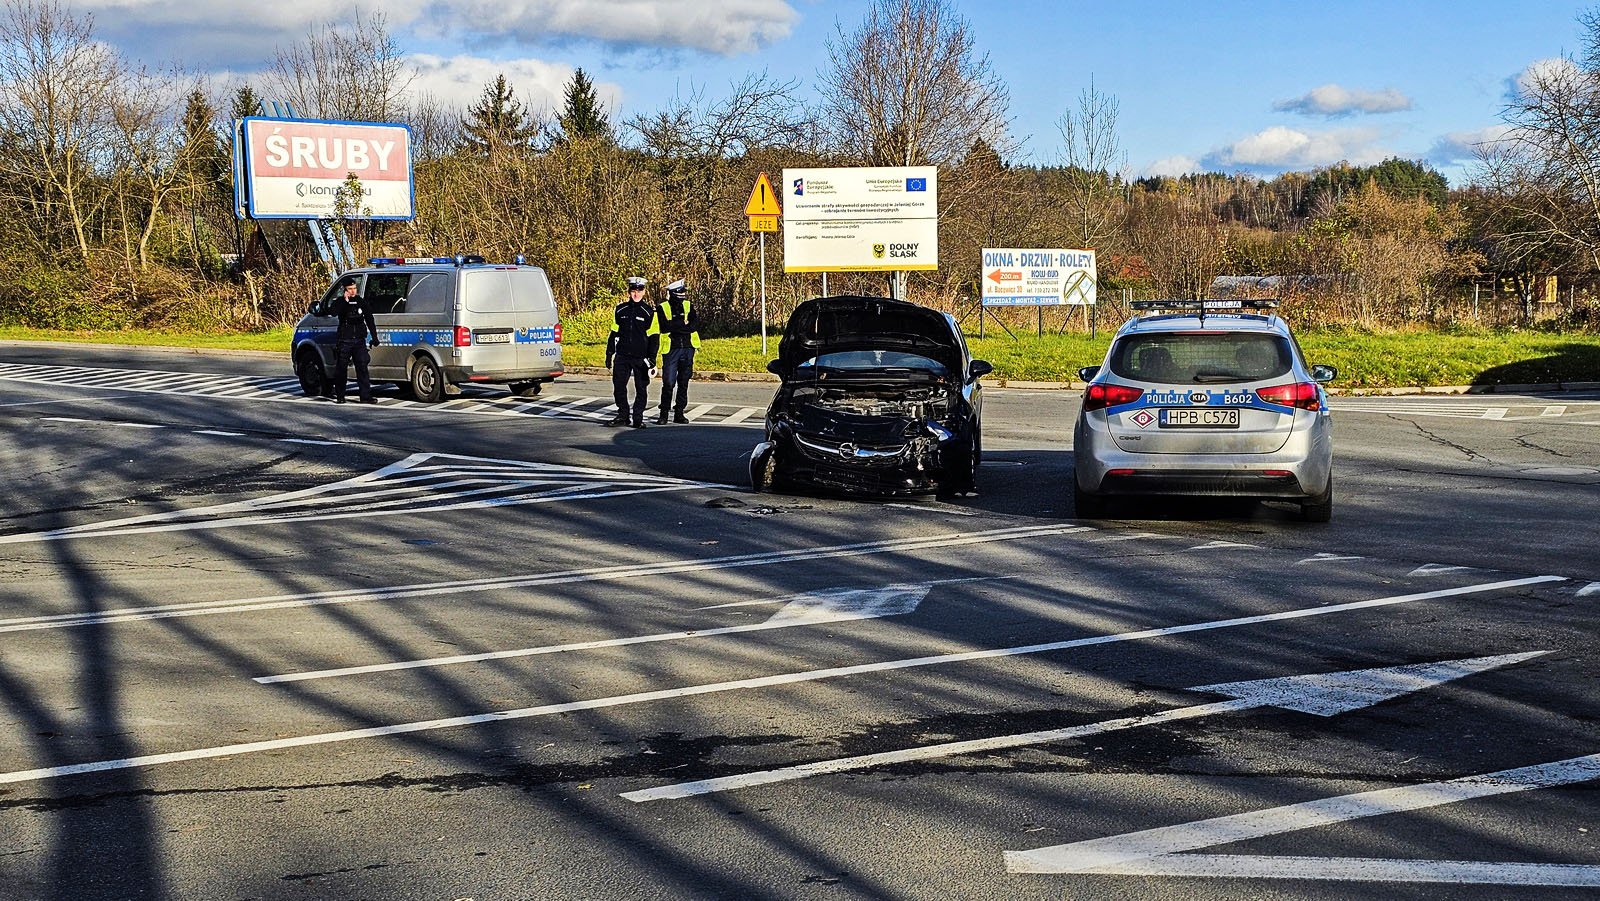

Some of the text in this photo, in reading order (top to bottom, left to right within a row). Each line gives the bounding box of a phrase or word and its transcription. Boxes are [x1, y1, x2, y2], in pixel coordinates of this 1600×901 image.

[265, 128, 395, 170] ŚRUBY
[890, 243, 919, 251] DOLNY
[985, 252, 1092, 268] OKNA DRZWI ROLETY
[435, 334, 452, 342] B600
[529, 332, 553, 340] POLICJA
[540, 348, 557, 357] B600
[1146, 394, 1186, 404] POLICJA
[1224, 394, 1253, 404] B602
[1169, 411, 1237, 424] HPB C578
